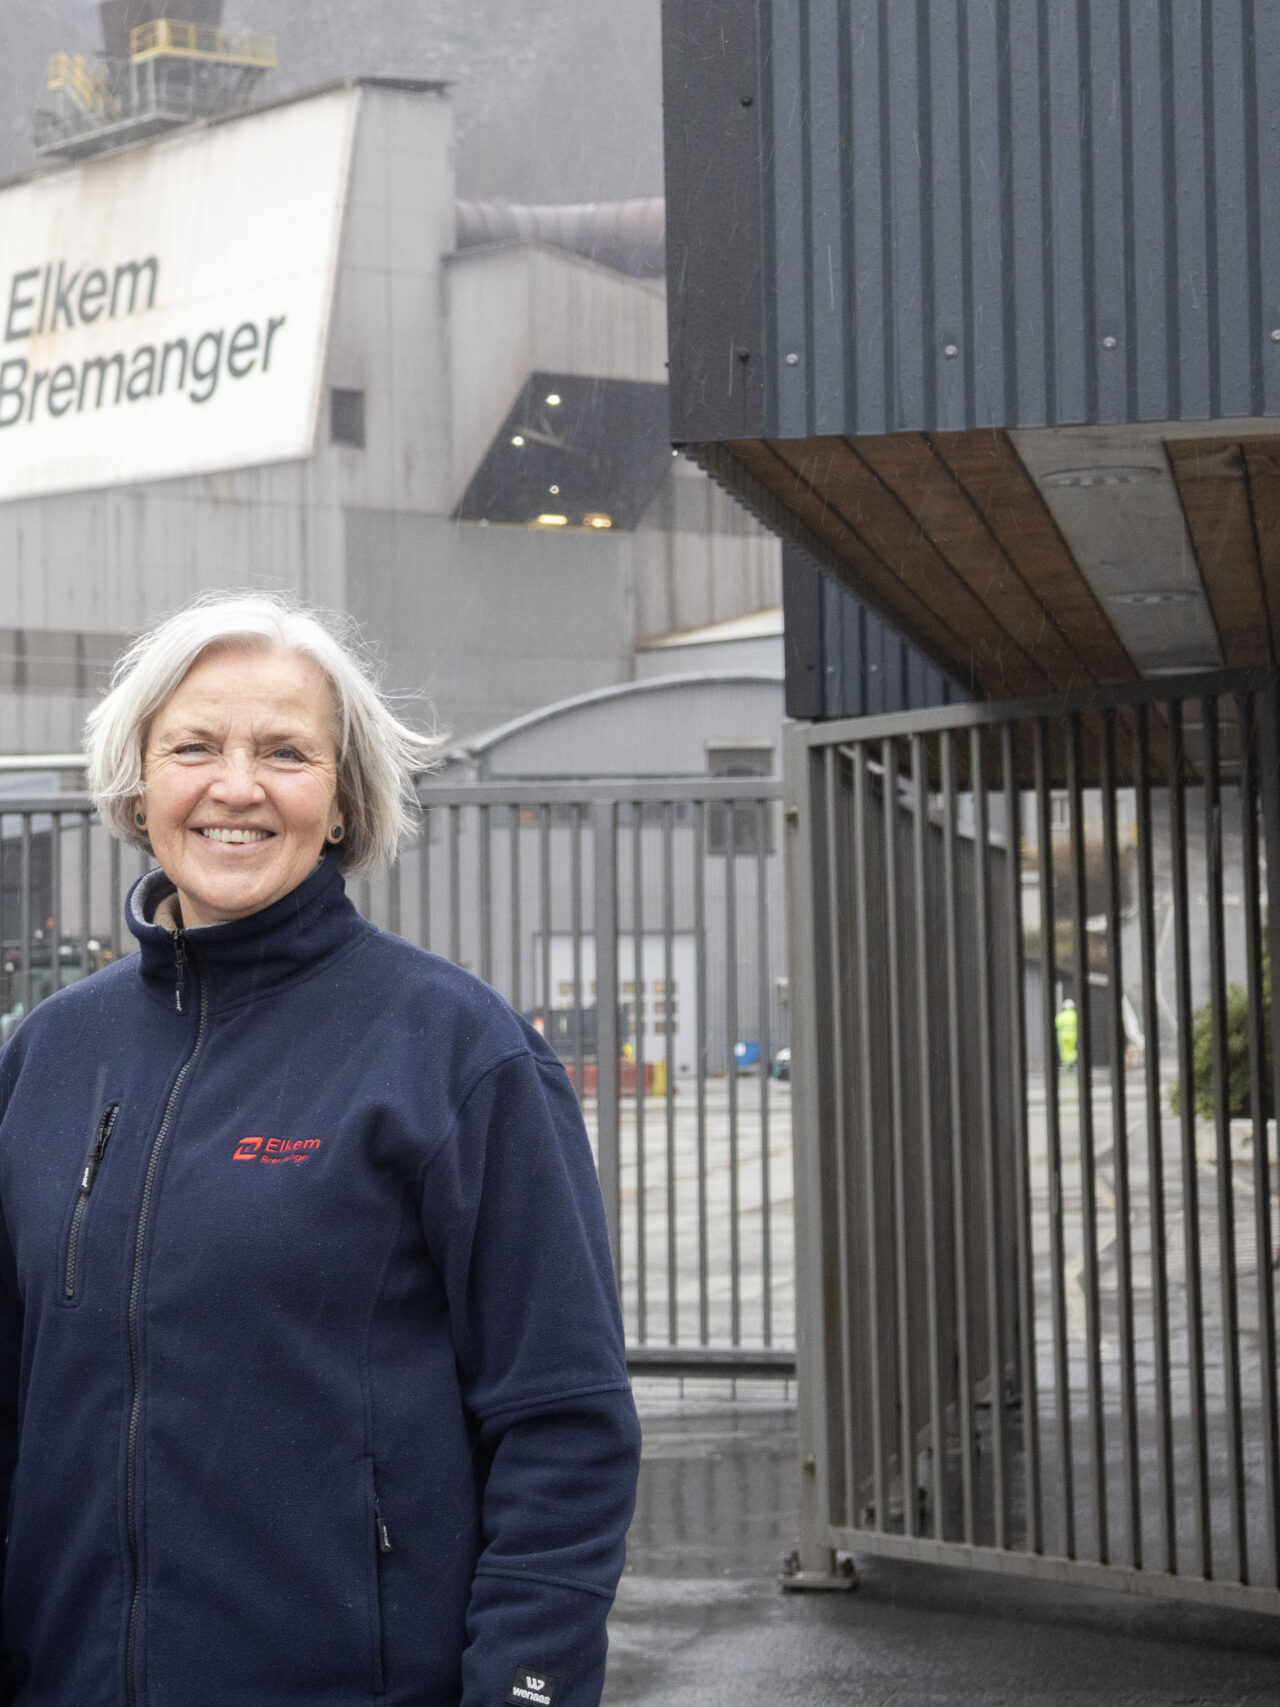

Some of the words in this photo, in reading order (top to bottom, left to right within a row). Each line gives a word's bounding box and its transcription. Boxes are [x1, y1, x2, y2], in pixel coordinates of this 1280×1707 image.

[4, 255, 160, 343] Elkem
[265, 1137, 321, 1152] Elkem
[513, 1687, 551, 1704] wenaas
